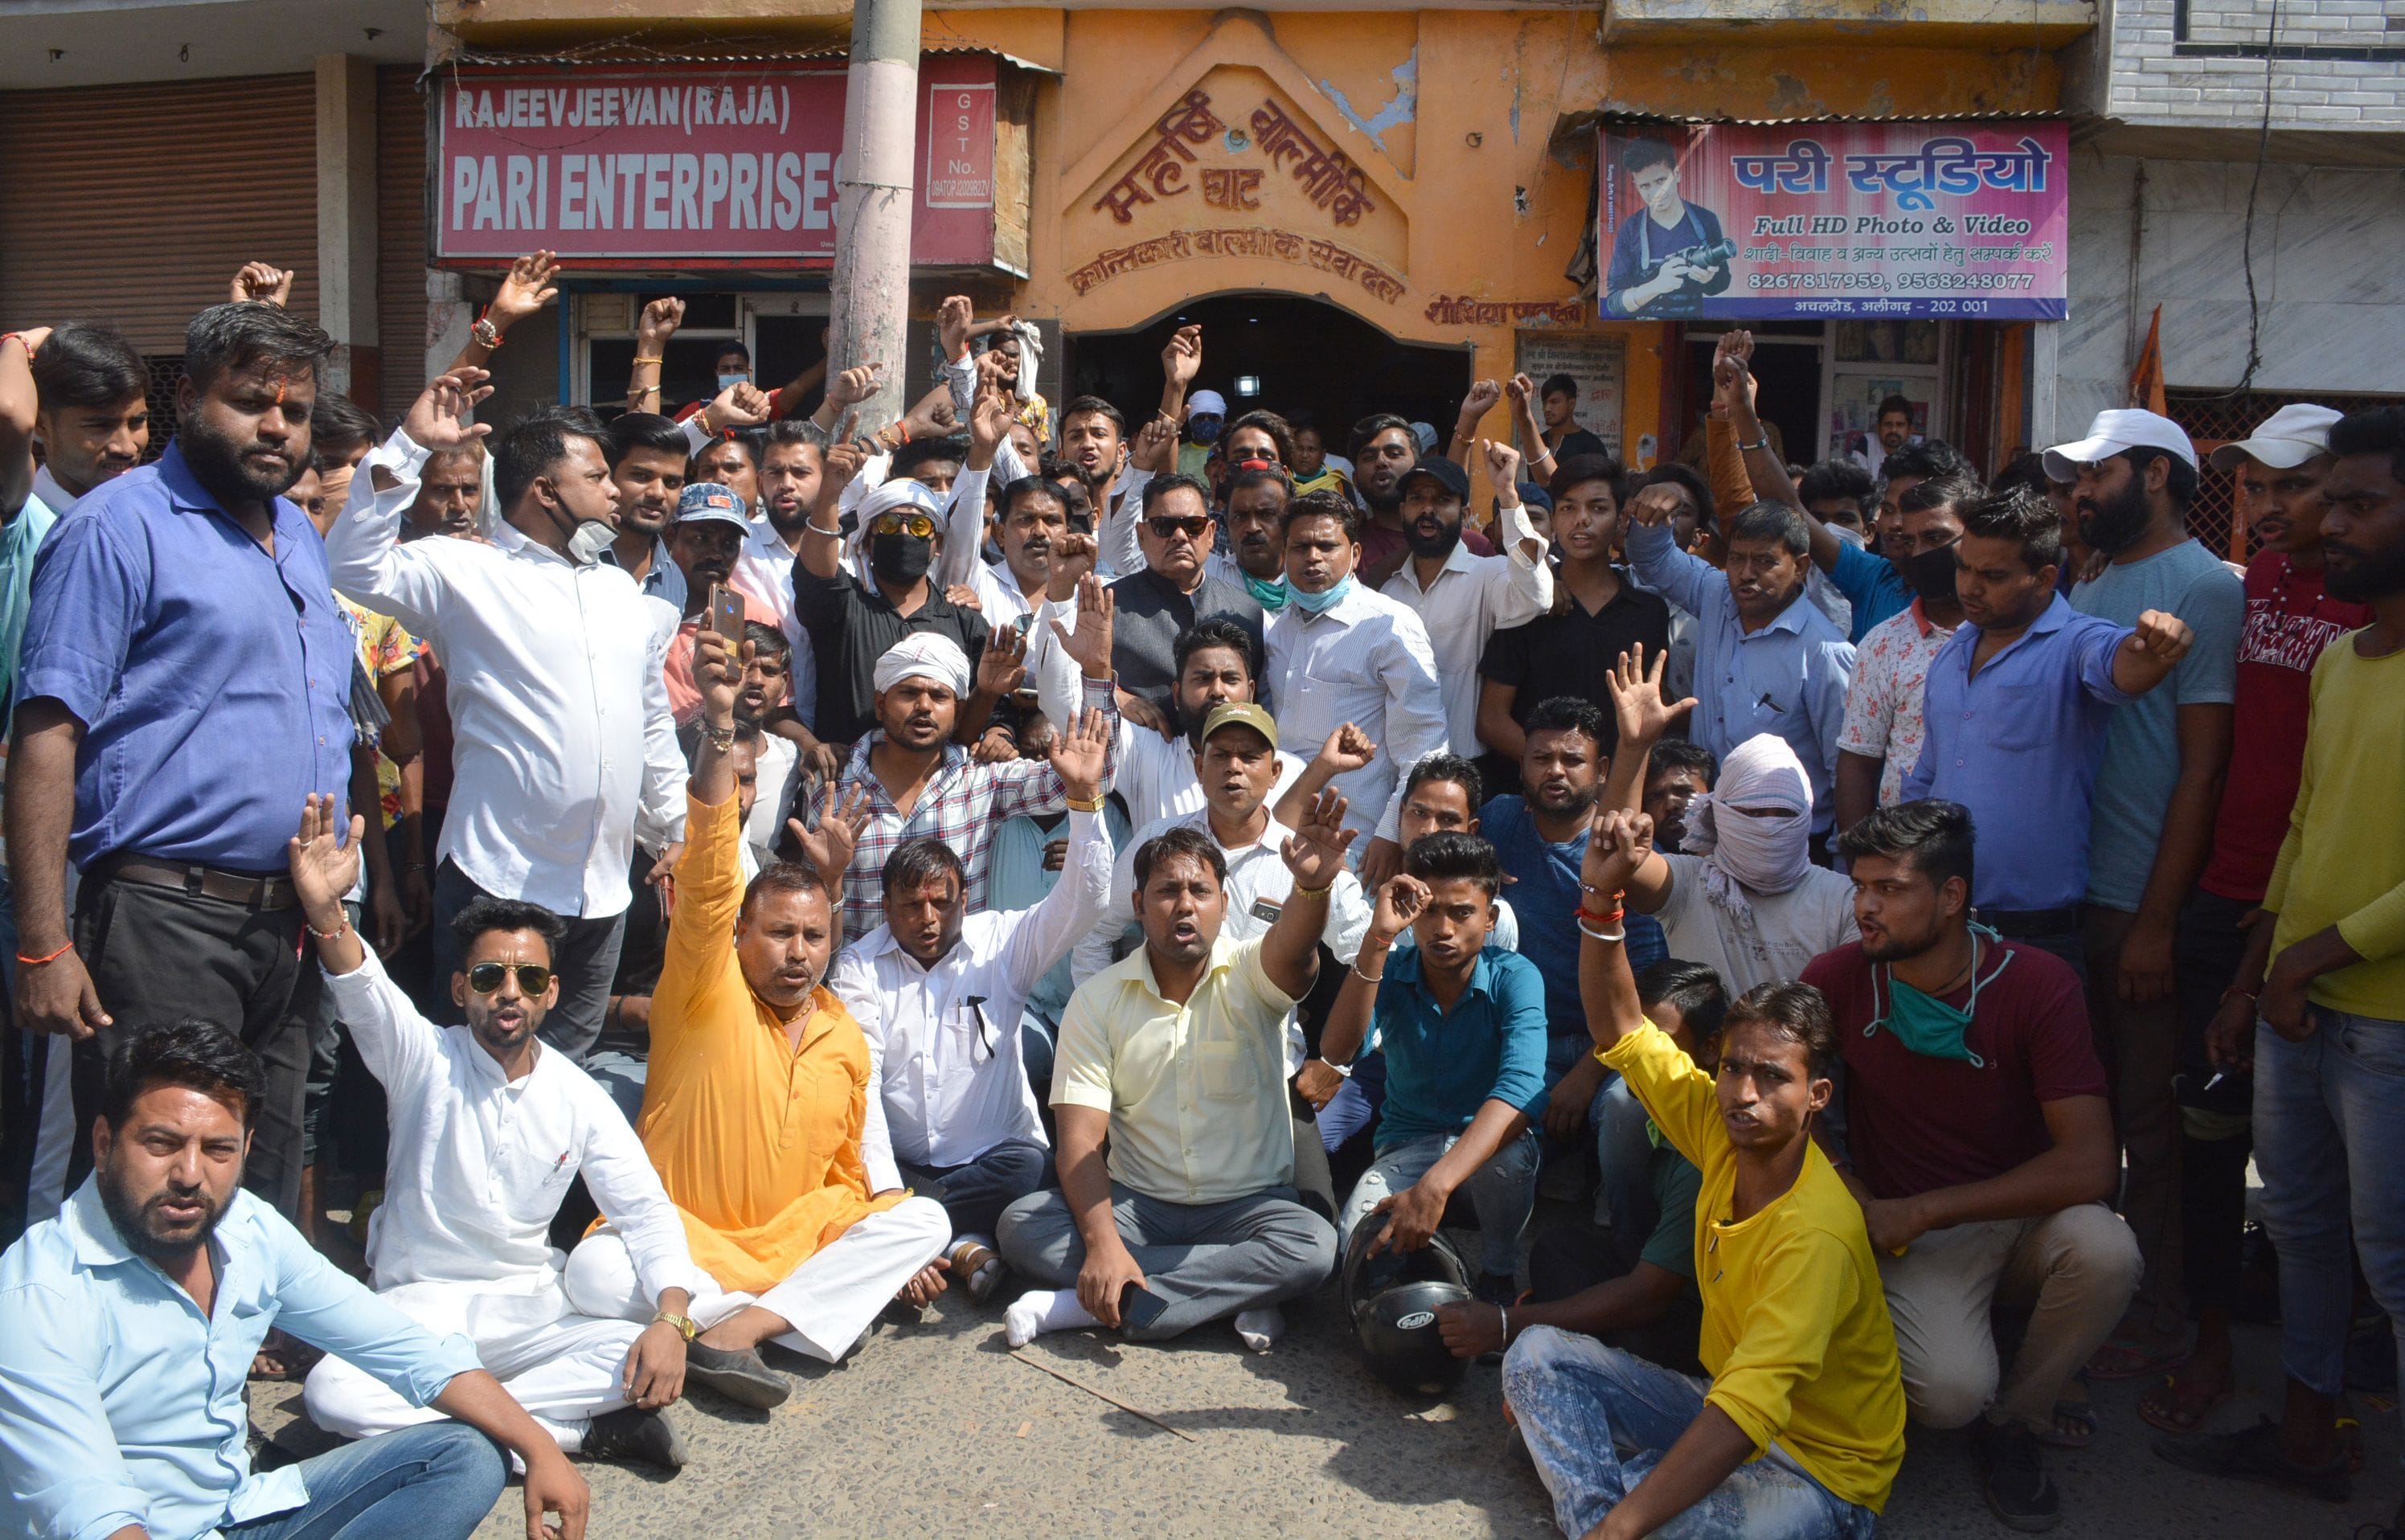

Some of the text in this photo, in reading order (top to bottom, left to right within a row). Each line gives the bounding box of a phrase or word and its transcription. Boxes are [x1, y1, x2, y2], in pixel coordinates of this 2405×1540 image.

[948, 158, 976, 174] No.
[1731, 137, 2051, 211] परी स्टूडियो
[453, 154, 548, 231] PARI
[1753, 215, 2030, 235] Full HD Photo & Video
[1836, 247, 1848, 261] व
[1852, 246, 1886, 263] अन्य
[1890, 243, 1939, 262] उत्सवों
[1942, 243, 1966, 267] हेतु
[1969, 242, 2022, 262] सम्पर्क
[2024, 243, 2053, 263] करें
[1748, 272, 2035, 292] 8267817959, 9568248077
[1930, 300, 1956, 313] 202
[1962, 300, 1988, 313] 001
